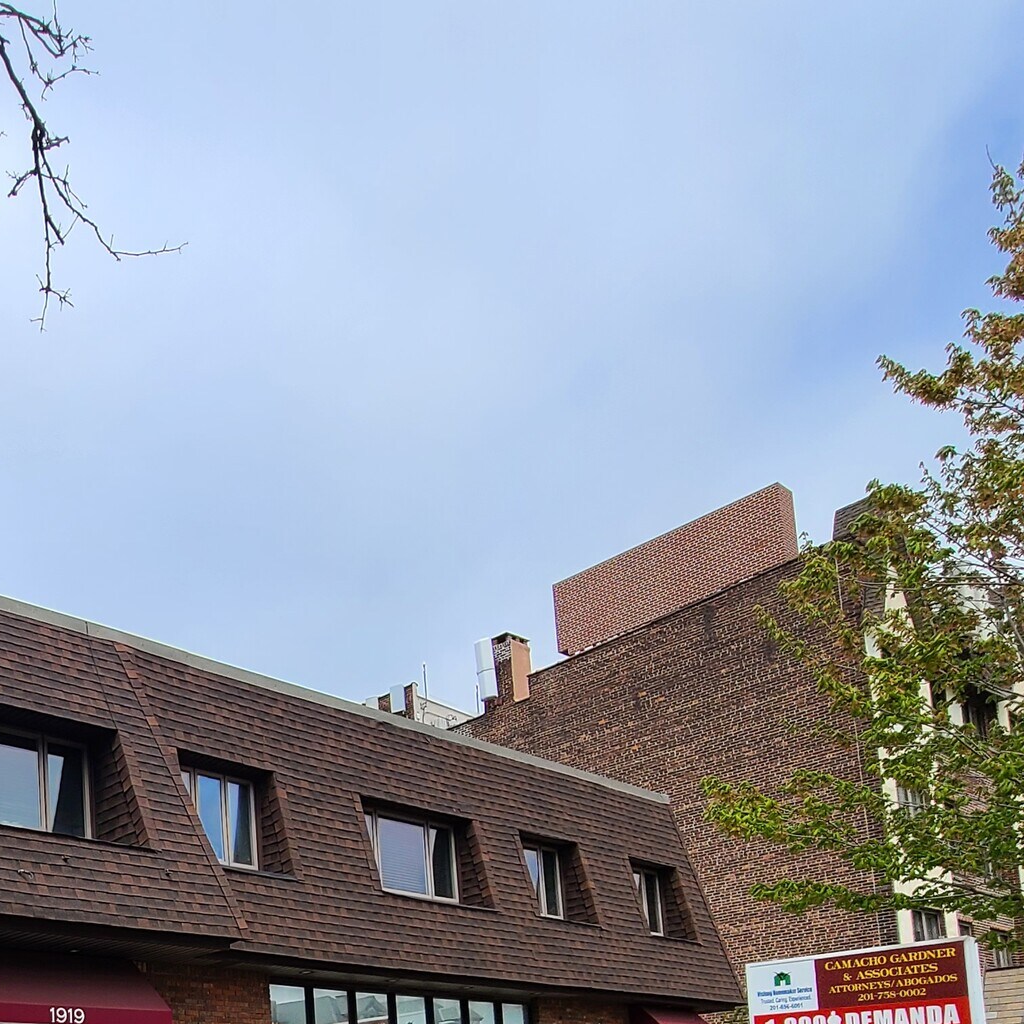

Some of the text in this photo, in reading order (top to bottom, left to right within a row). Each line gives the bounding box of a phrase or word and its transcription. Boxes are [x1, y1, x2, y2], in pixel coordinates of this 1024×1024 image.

[824, 947, 956, 971] CAMACHO GARDNER
[842, 963, 938, 981] & ASSOCIATES
[829, 973, 957, 994] ATTORNEYS/ABOGADOS
[857, 988, 927, 1002] 201-758-0002
[50, 1007, 85, 1024] 1919
